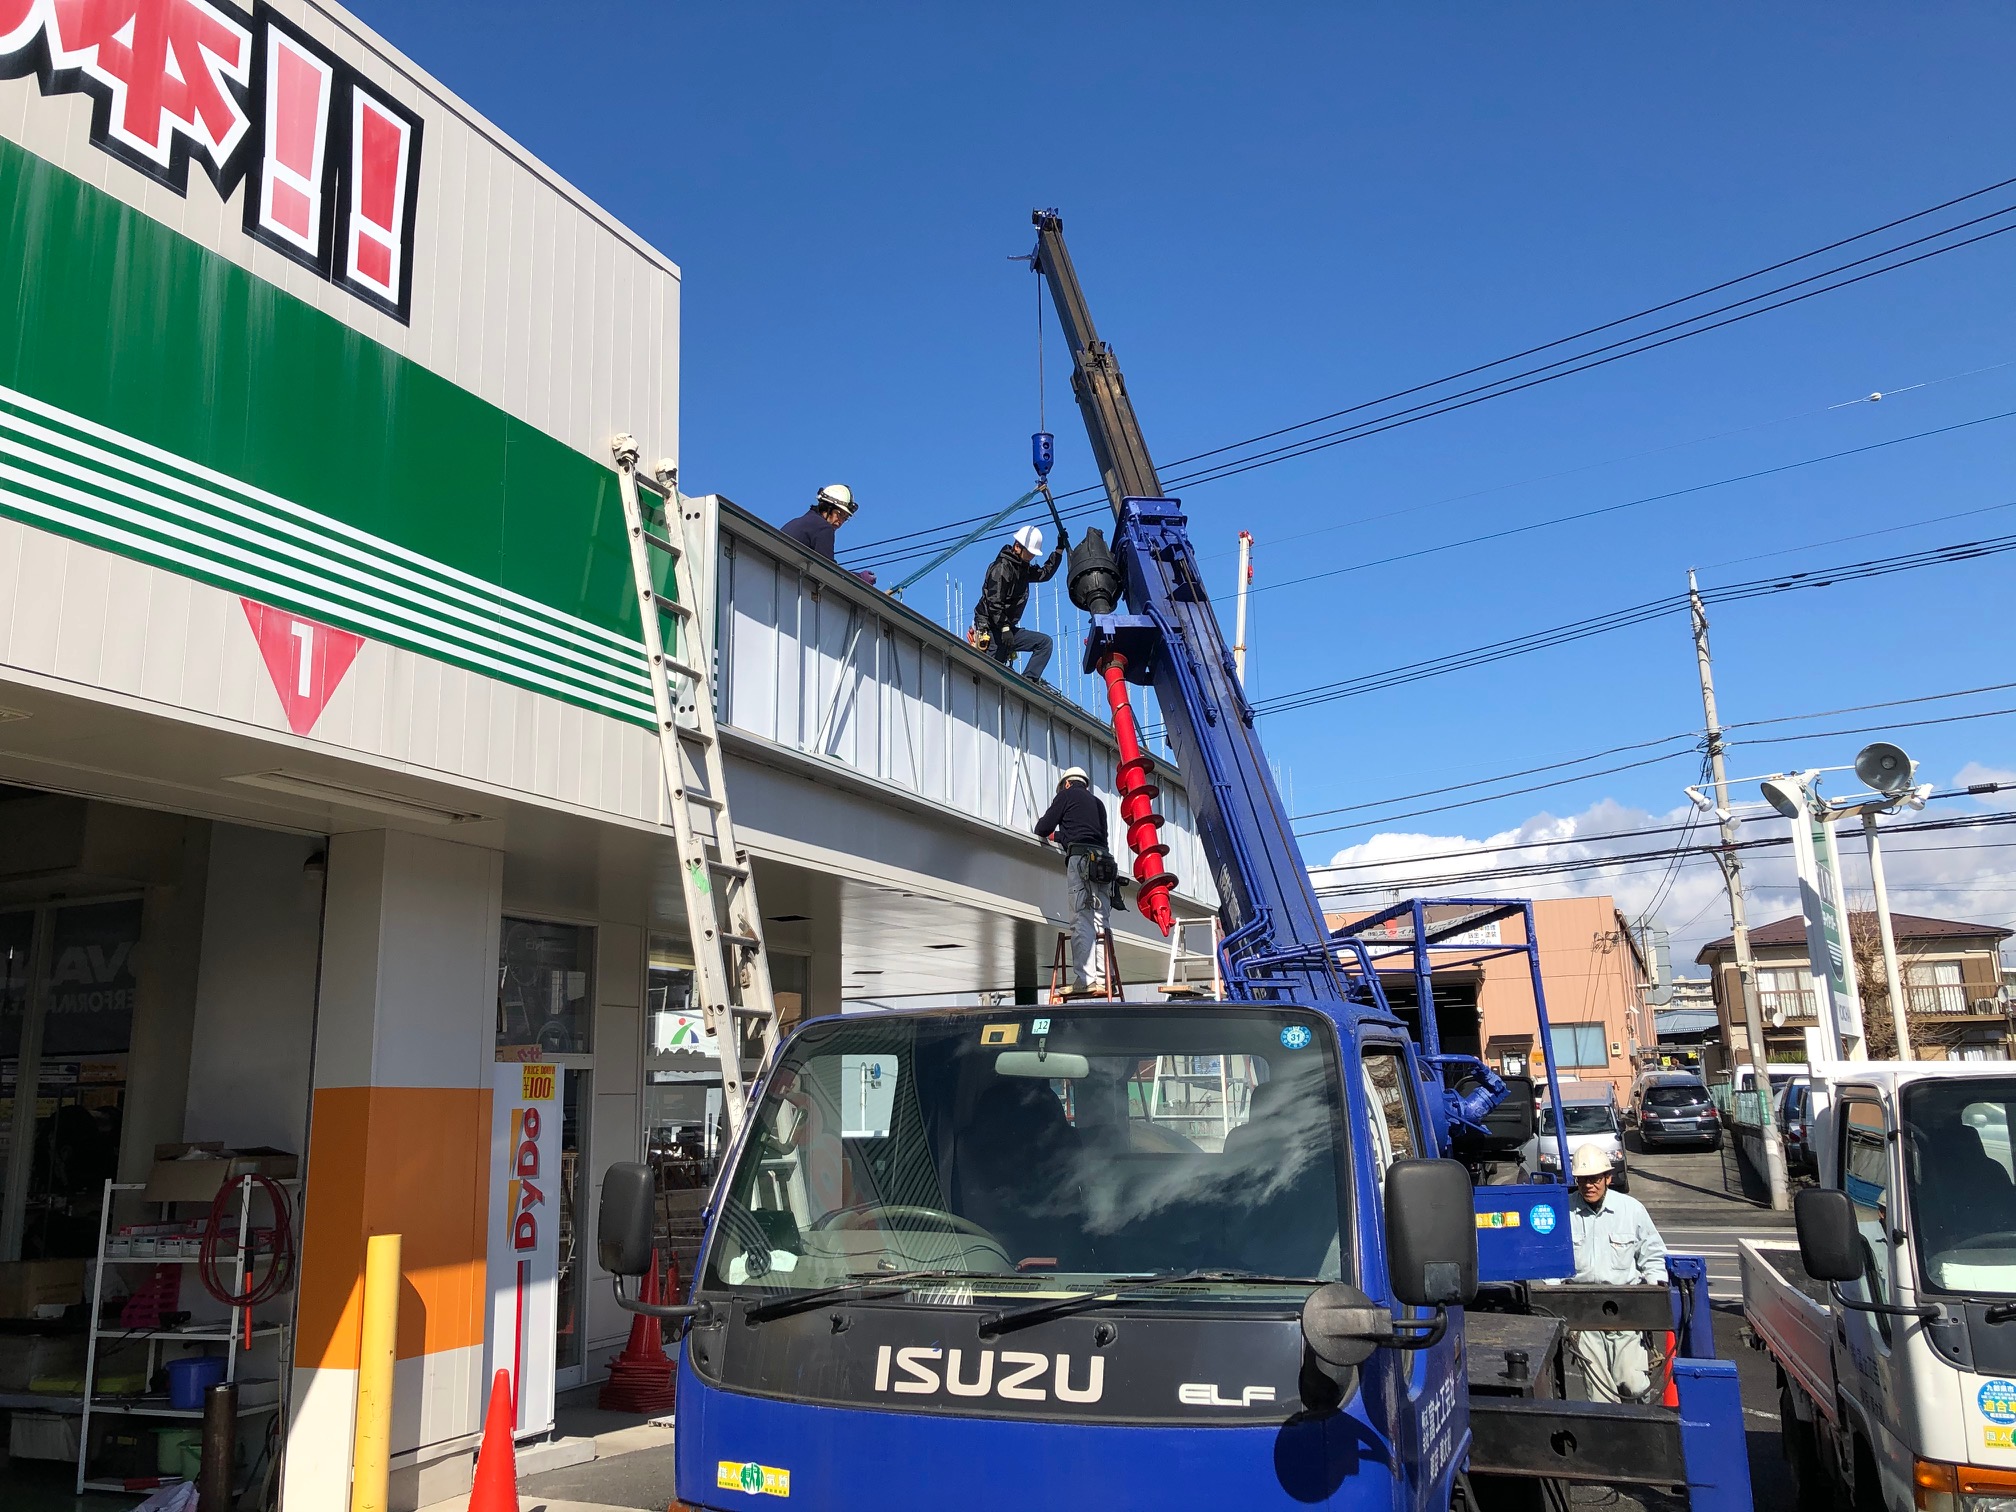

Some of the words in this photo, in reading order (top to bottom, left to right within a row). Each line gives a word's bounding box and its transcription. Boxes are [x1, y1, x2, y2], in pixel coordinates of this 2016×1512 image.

[291, 620, 314, 698] 1
[1038, 1021, 1049, 1030] 12
[1290, 1033, 1301, 1042] 31
[874, 1345, 1106, 1403] ISUZU
[1178, 1383, 1276, 1407] ELF
